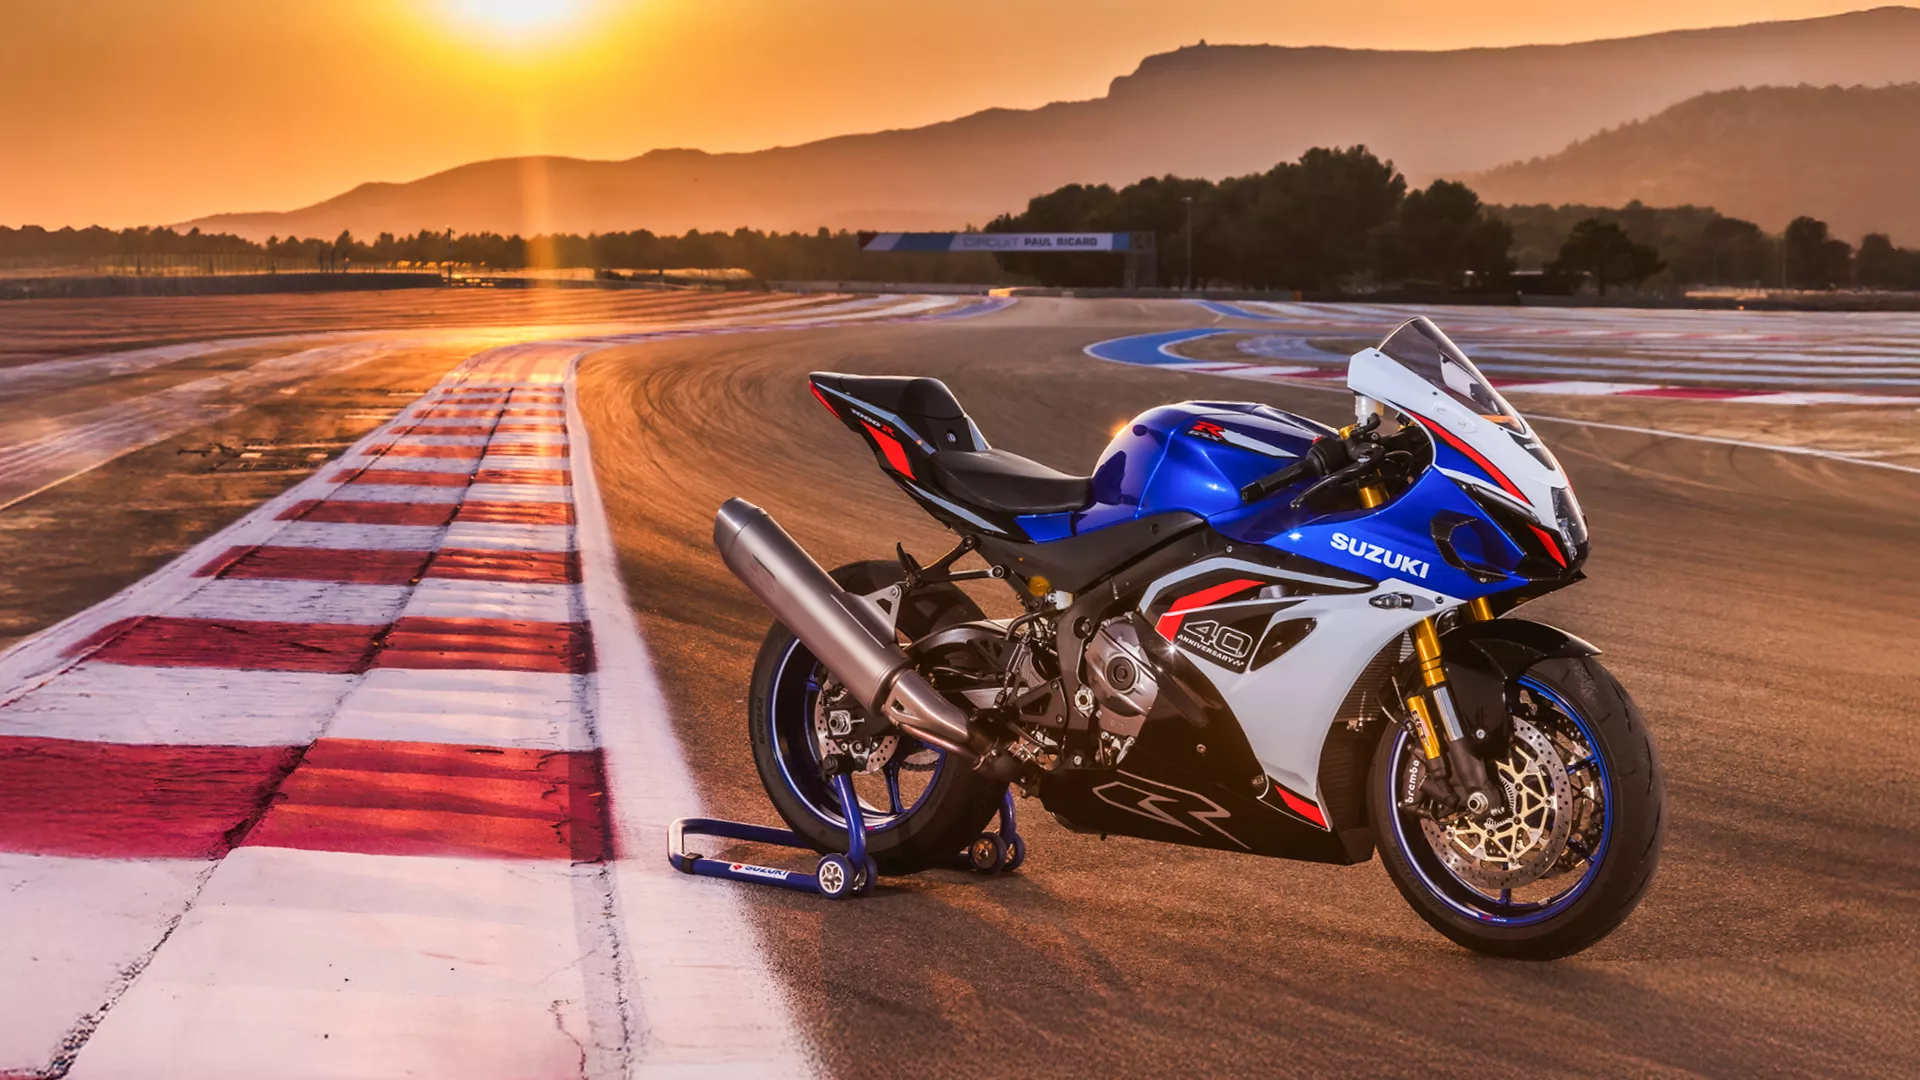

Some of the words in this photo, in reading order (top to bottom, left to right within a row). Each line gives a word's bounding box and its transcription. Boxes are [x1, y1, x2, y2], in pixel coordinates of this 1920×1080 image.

[1024, 236, 1052, 247] PAUL
[1056, 236, 1098, 247] RICARD
[1330, 532, 1430, 579] SUZUKI
[1176, 633, 1235, 665] ANNIVERSARY
[1405, 760, 1419, 804] brembo
[745, 865, 788, 877] SUZUKI
